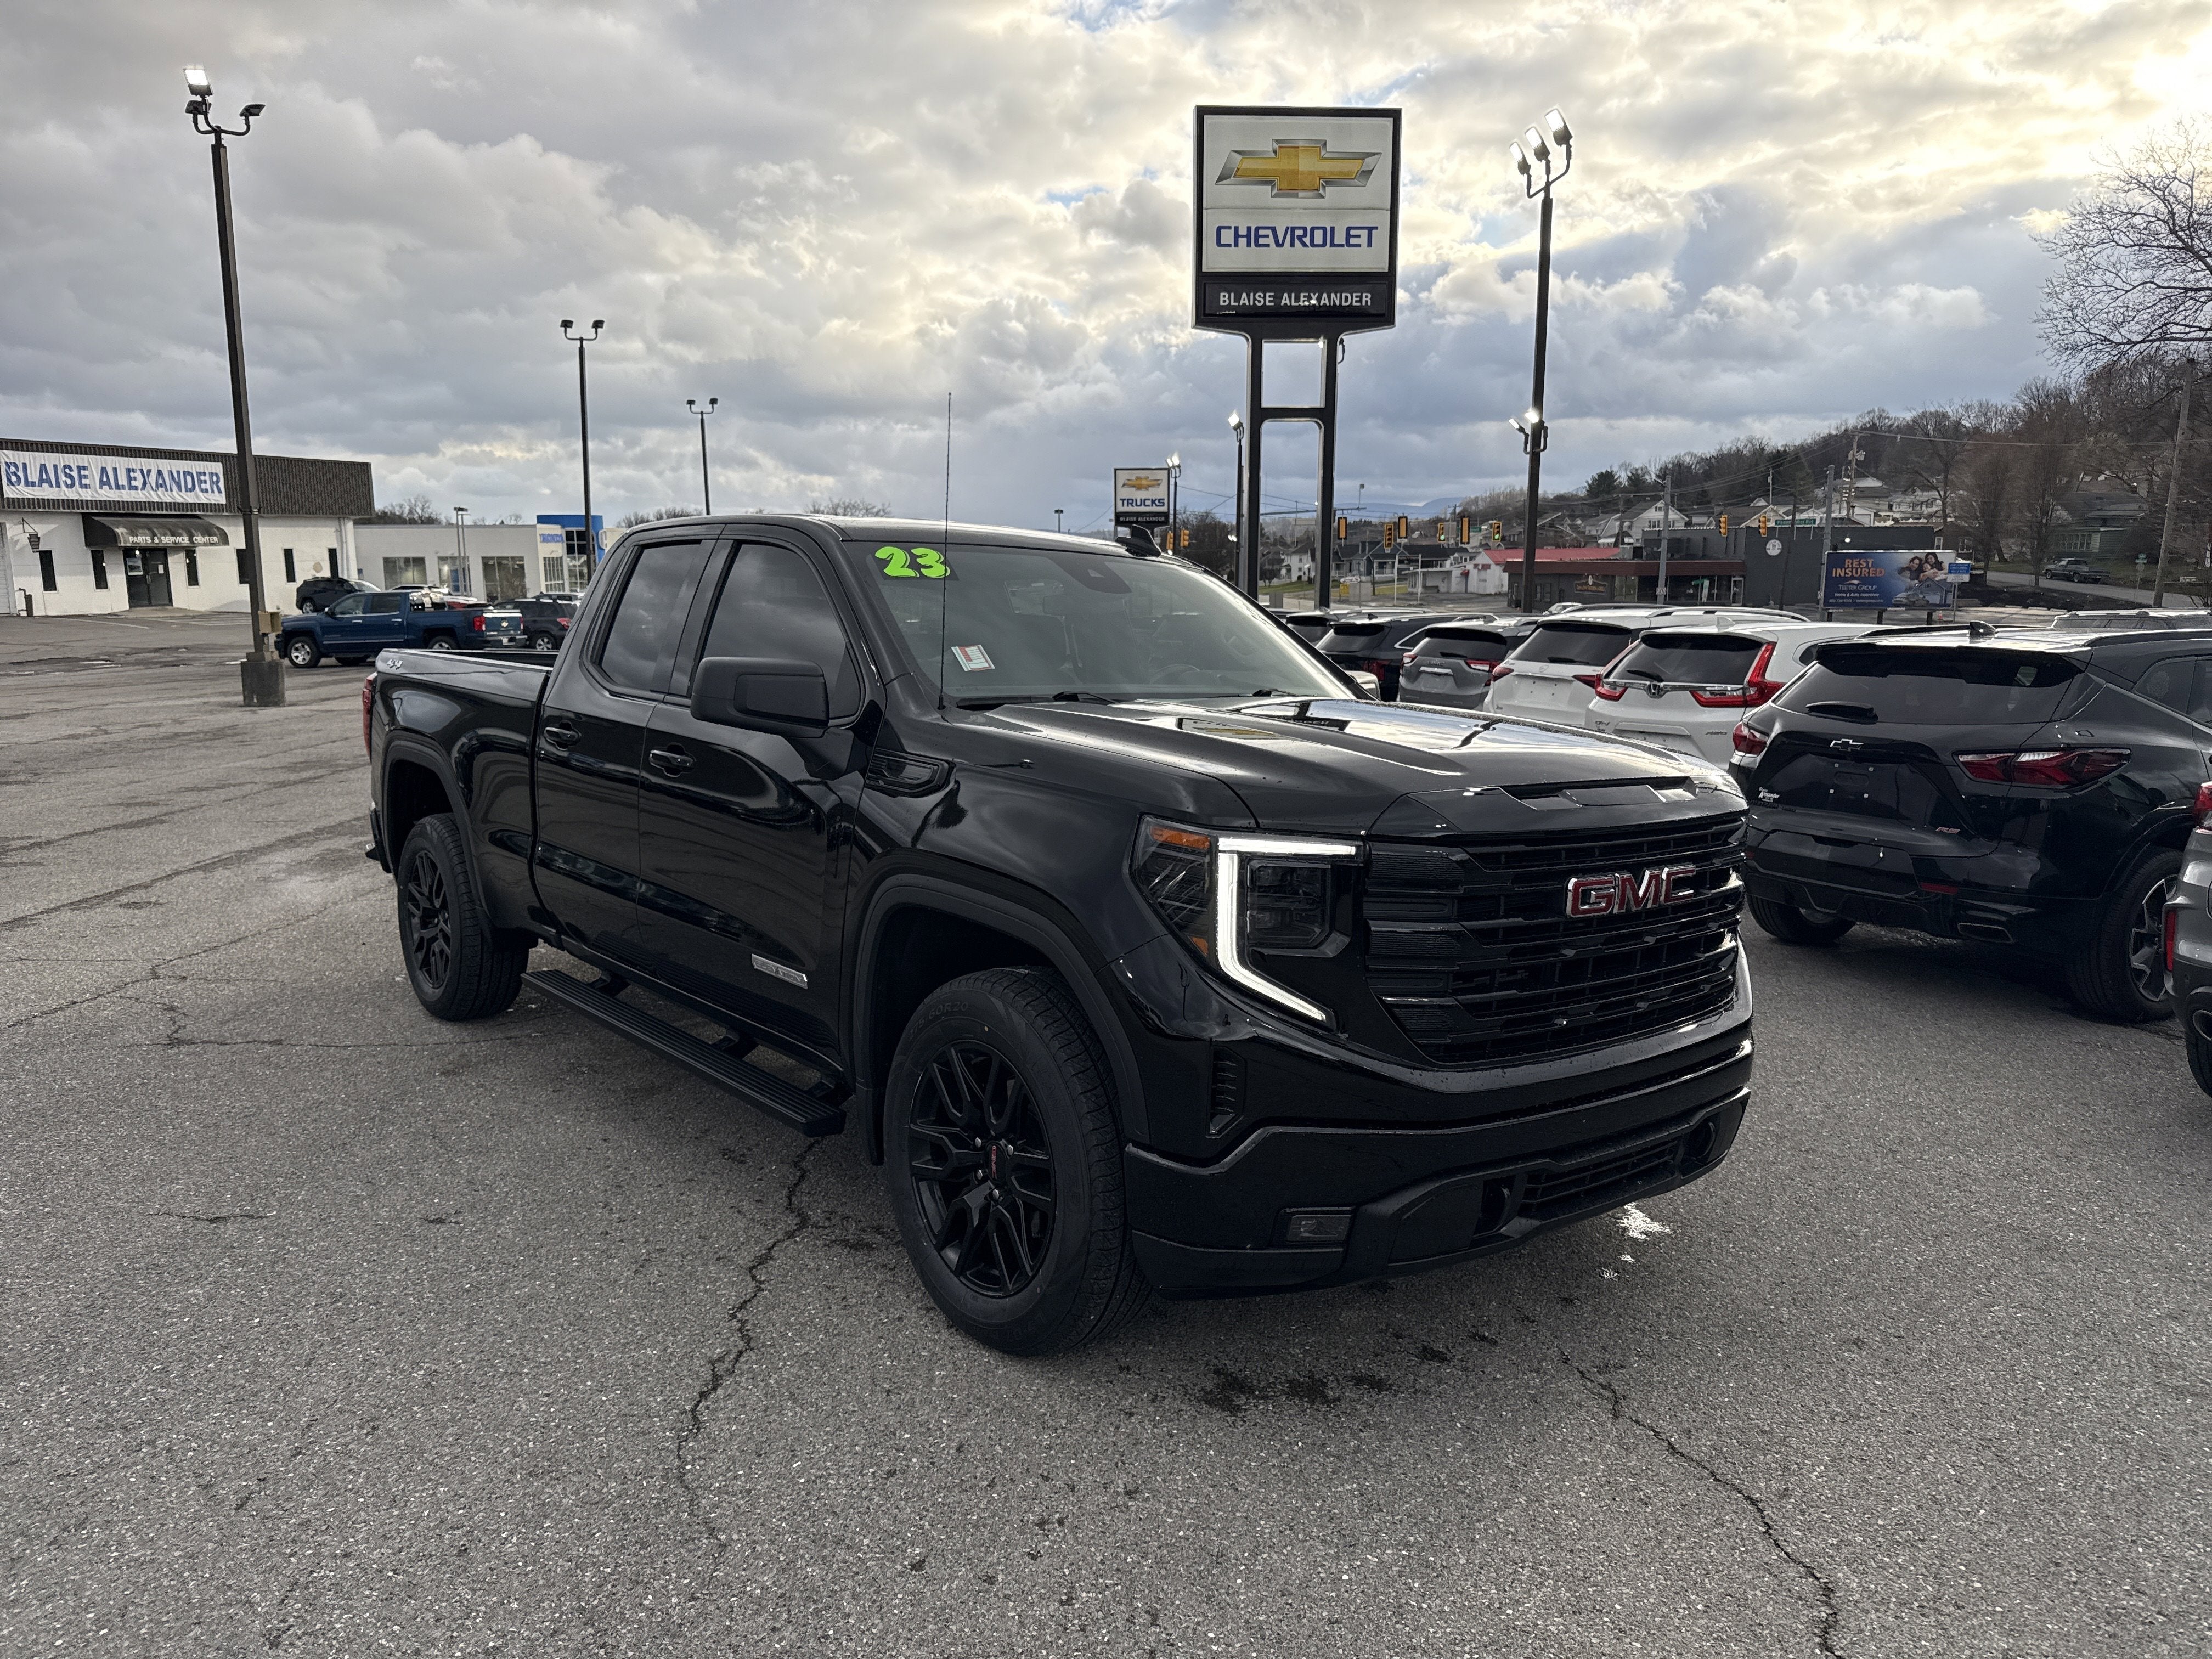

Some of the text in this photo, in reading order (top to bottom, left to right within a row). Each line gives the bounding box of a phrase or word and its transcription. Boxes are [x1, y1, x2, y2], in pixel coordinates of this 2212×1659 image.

[1216, 225, 1379, 248] CHEVROLET
[1220, 292, 1372, 306] BLAISE ALEXANDER
[4, 461, 223, 494] BLAISE ALEXANDER
[1119, 498, 1165, 507] TRUCKS
[161, 536, 190, 544] SERVICE
[193, 536, 218, 544] CENTER
[874, 546, 951, 578] 23
[1844, 558, 1874, 568] REST
[1832, 568, 1886, 577] INSURED
[1566, 864, 1696, 918] GMC
